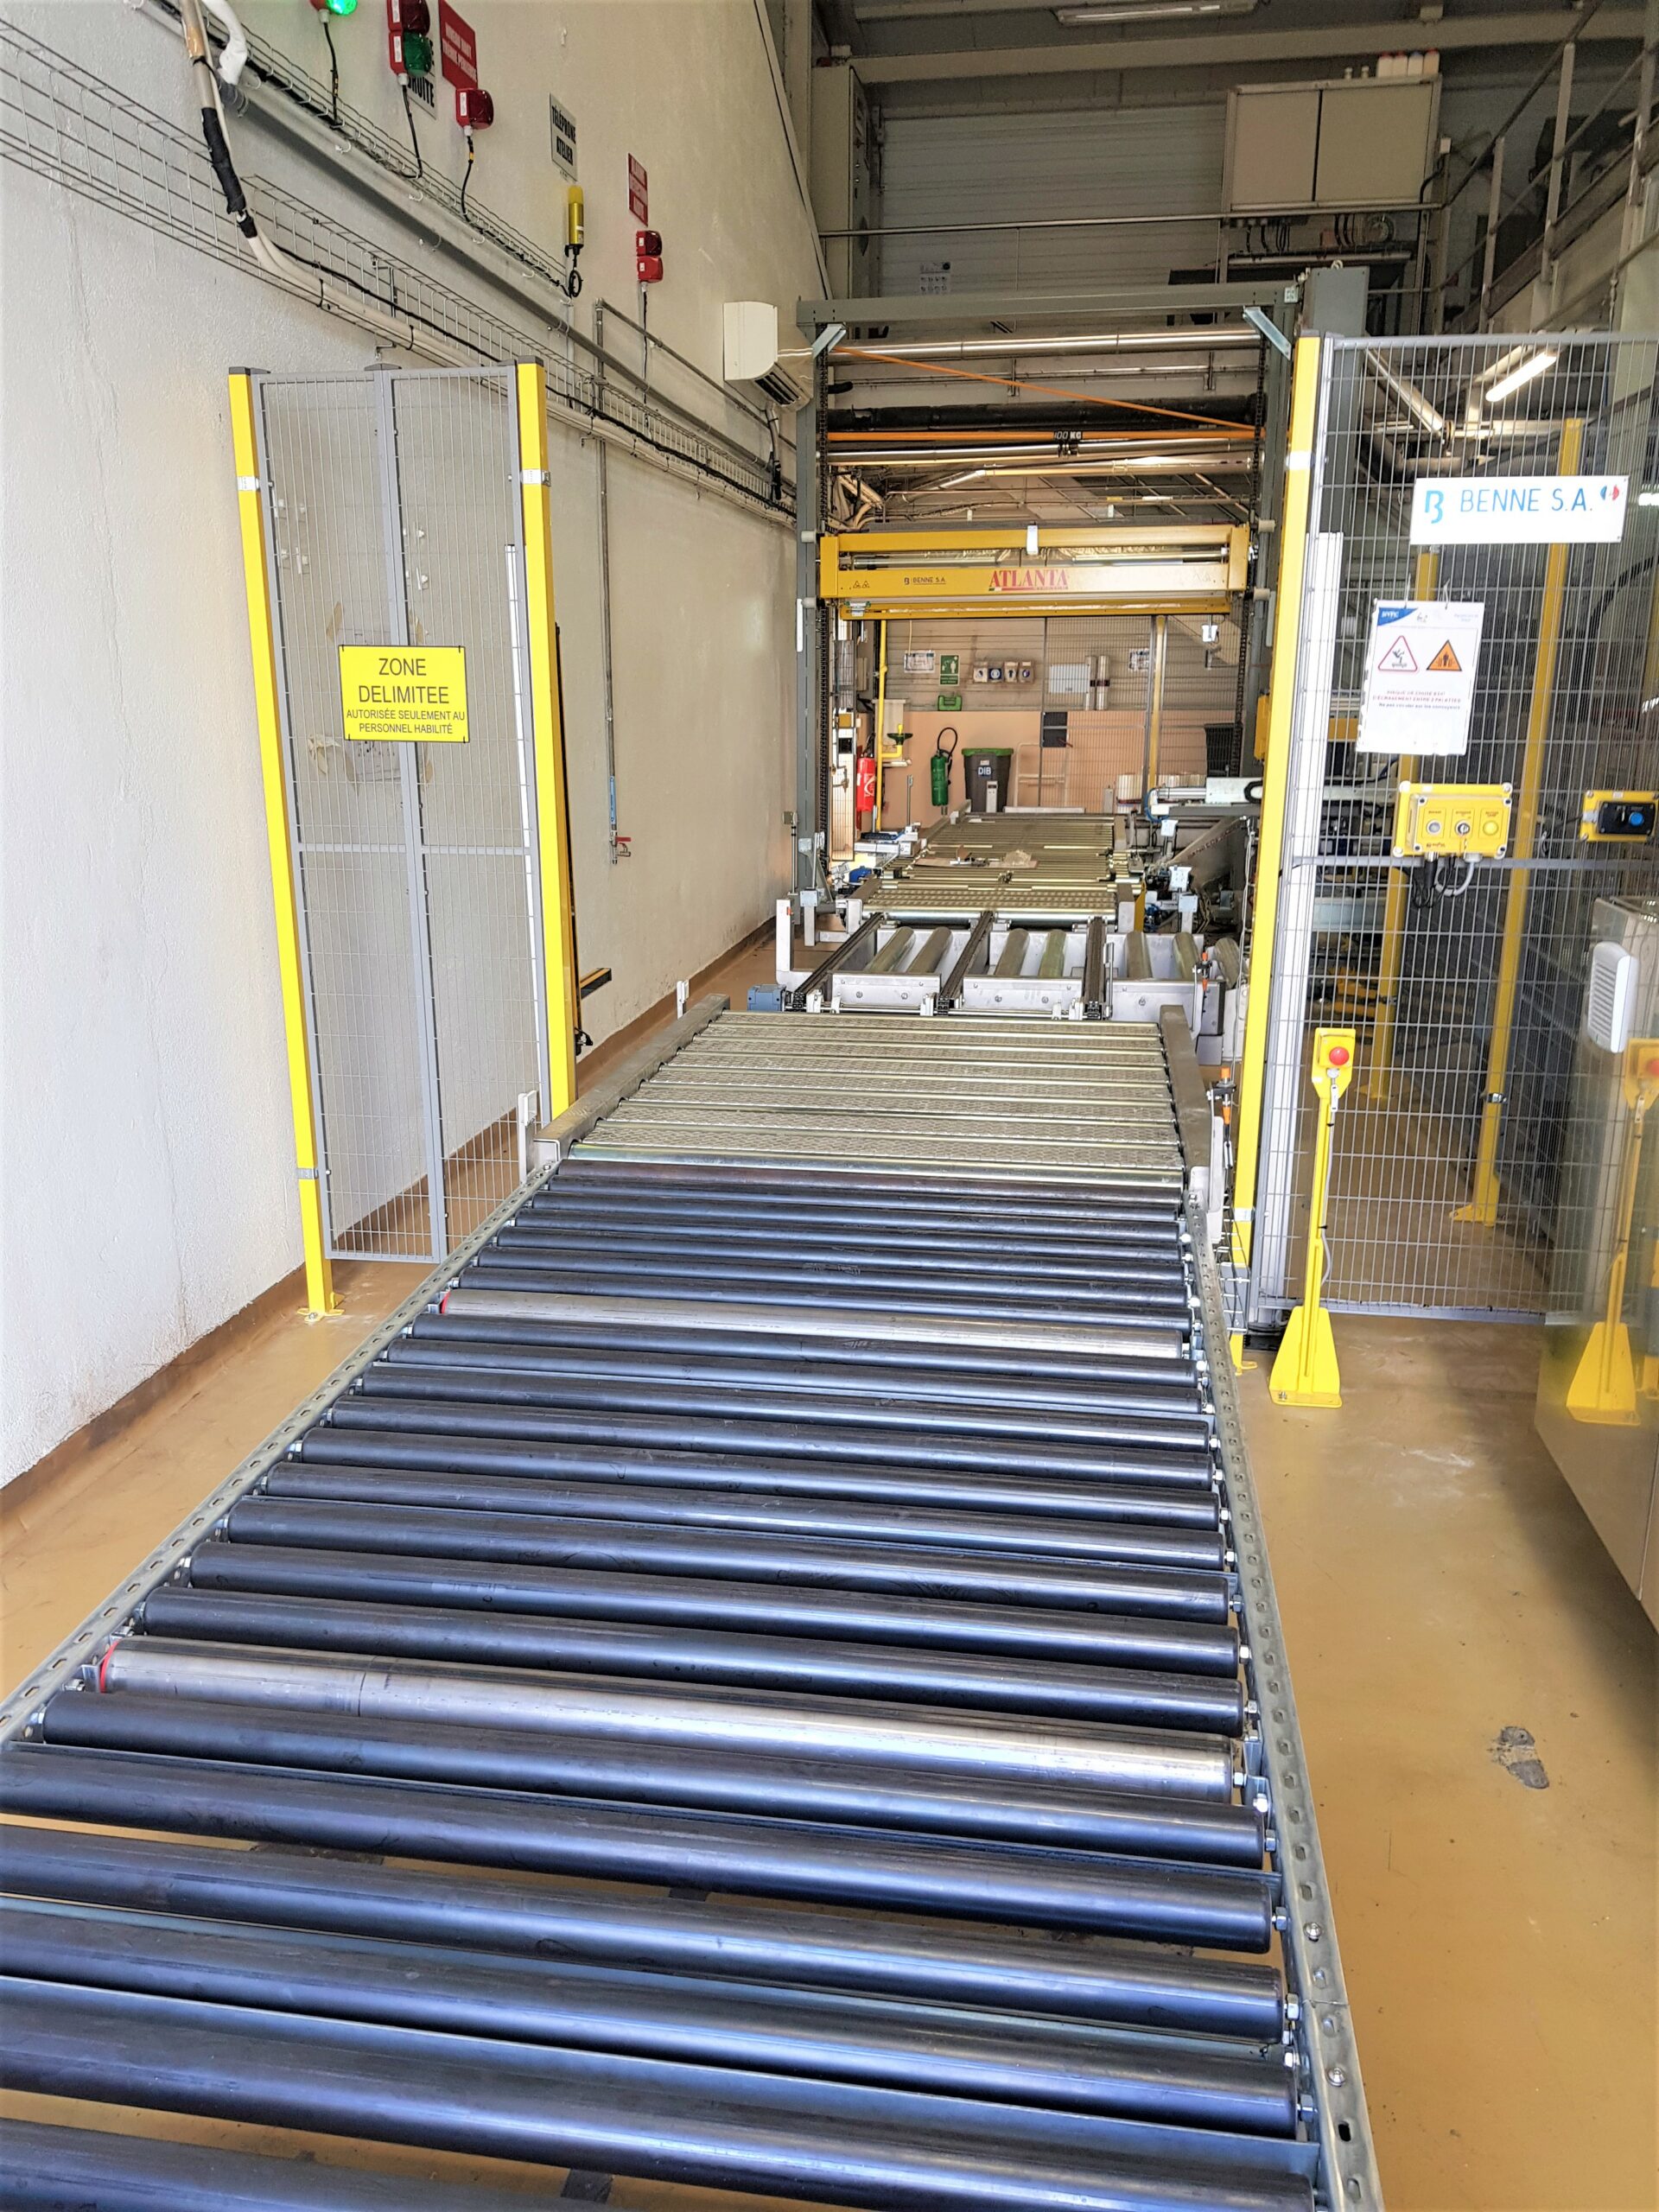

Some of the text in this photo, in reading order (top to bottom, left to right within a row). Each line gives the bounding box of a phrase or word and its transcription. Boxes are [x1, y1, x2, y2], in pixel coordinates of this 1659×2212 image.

[1460, 487, 1542, 512] BENNE
[988, 568, 1069, 588] ATLANTA
[378, 658, 427, 677] ZONE
[359, 685, 449, 704] DELIMITEE
[346, 708, 465, 721] AUTORISÉE SEULEMENT AU
[359, 722, 454, 734] PERSONNEL HABILITÉ
[977, 766, 992, 775] DIB
